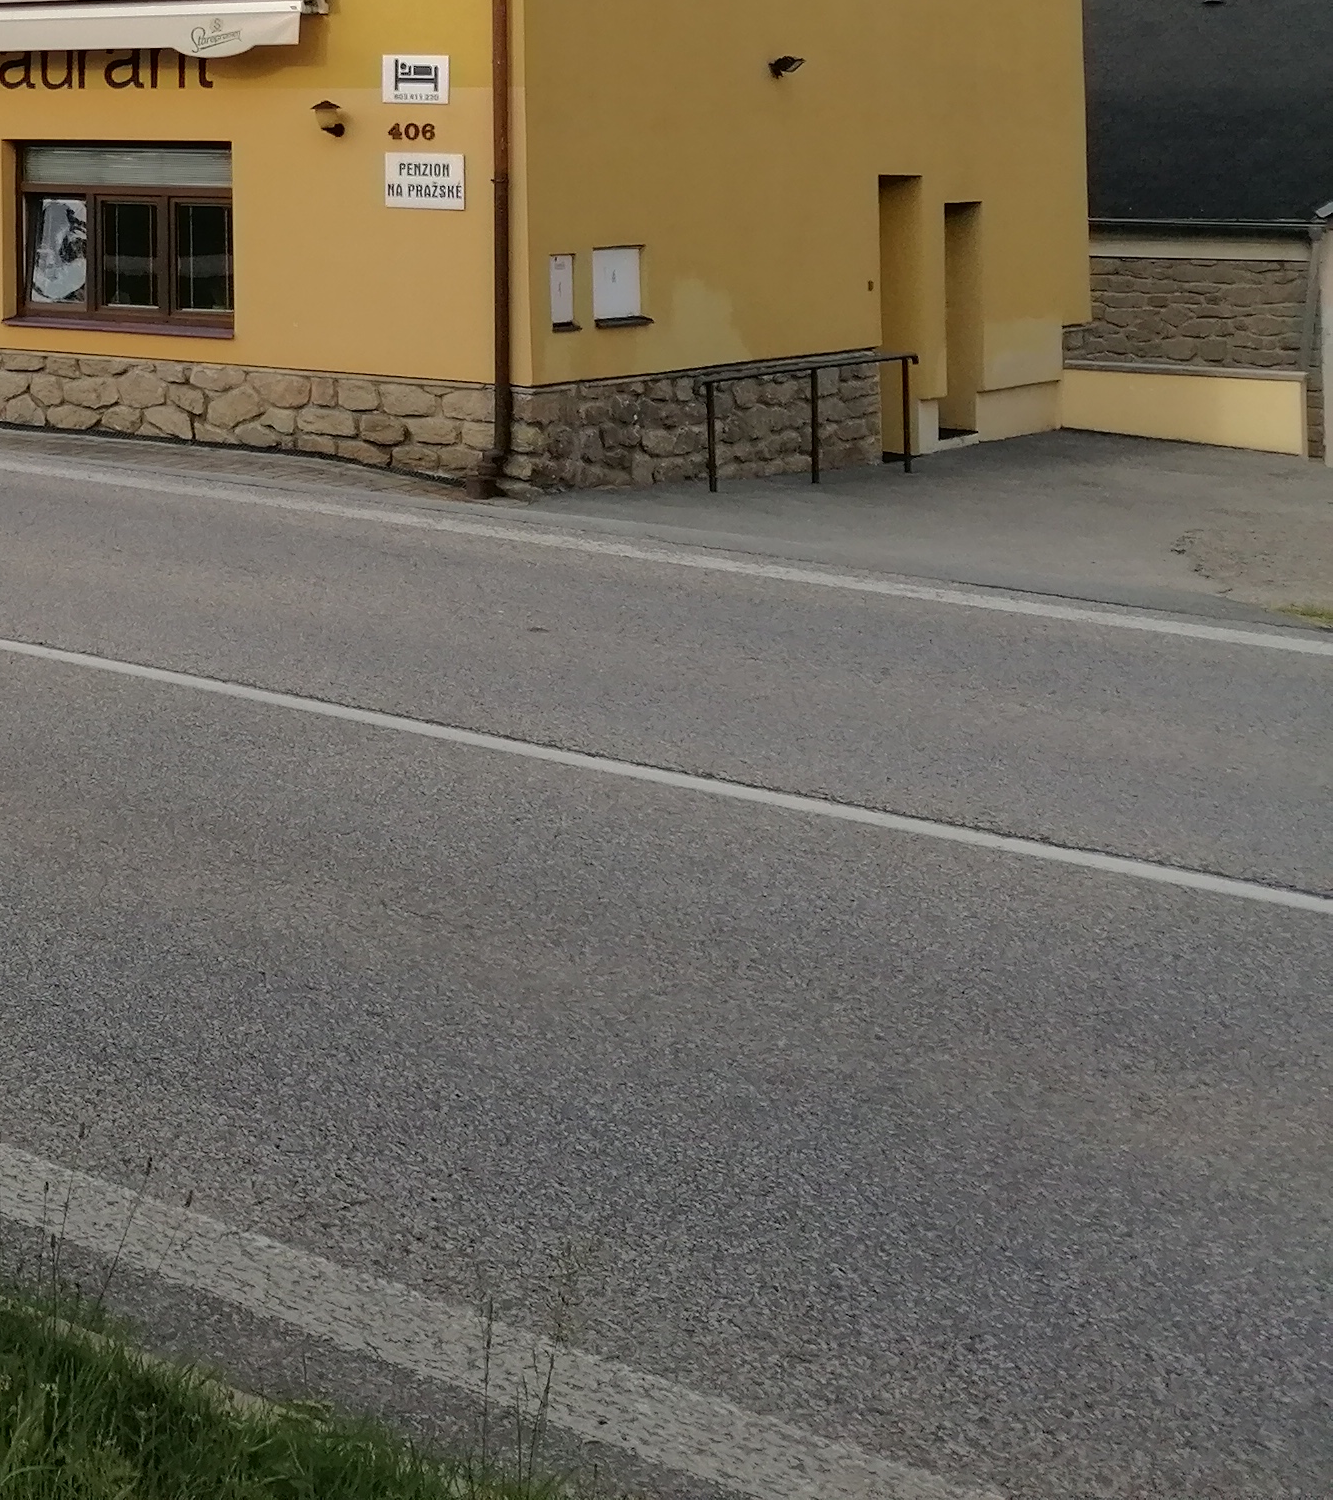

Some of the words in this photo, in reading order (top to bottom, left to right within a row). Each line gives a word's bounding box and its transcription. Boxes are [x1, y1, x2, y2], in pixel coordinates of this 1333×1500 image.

[388, 122, 436, 141] 406
[399, 162, 450, 178] PENZION
[387, 183, 403, 198] NA
[408, 181, 463, 199] PRAŽSKÉ
